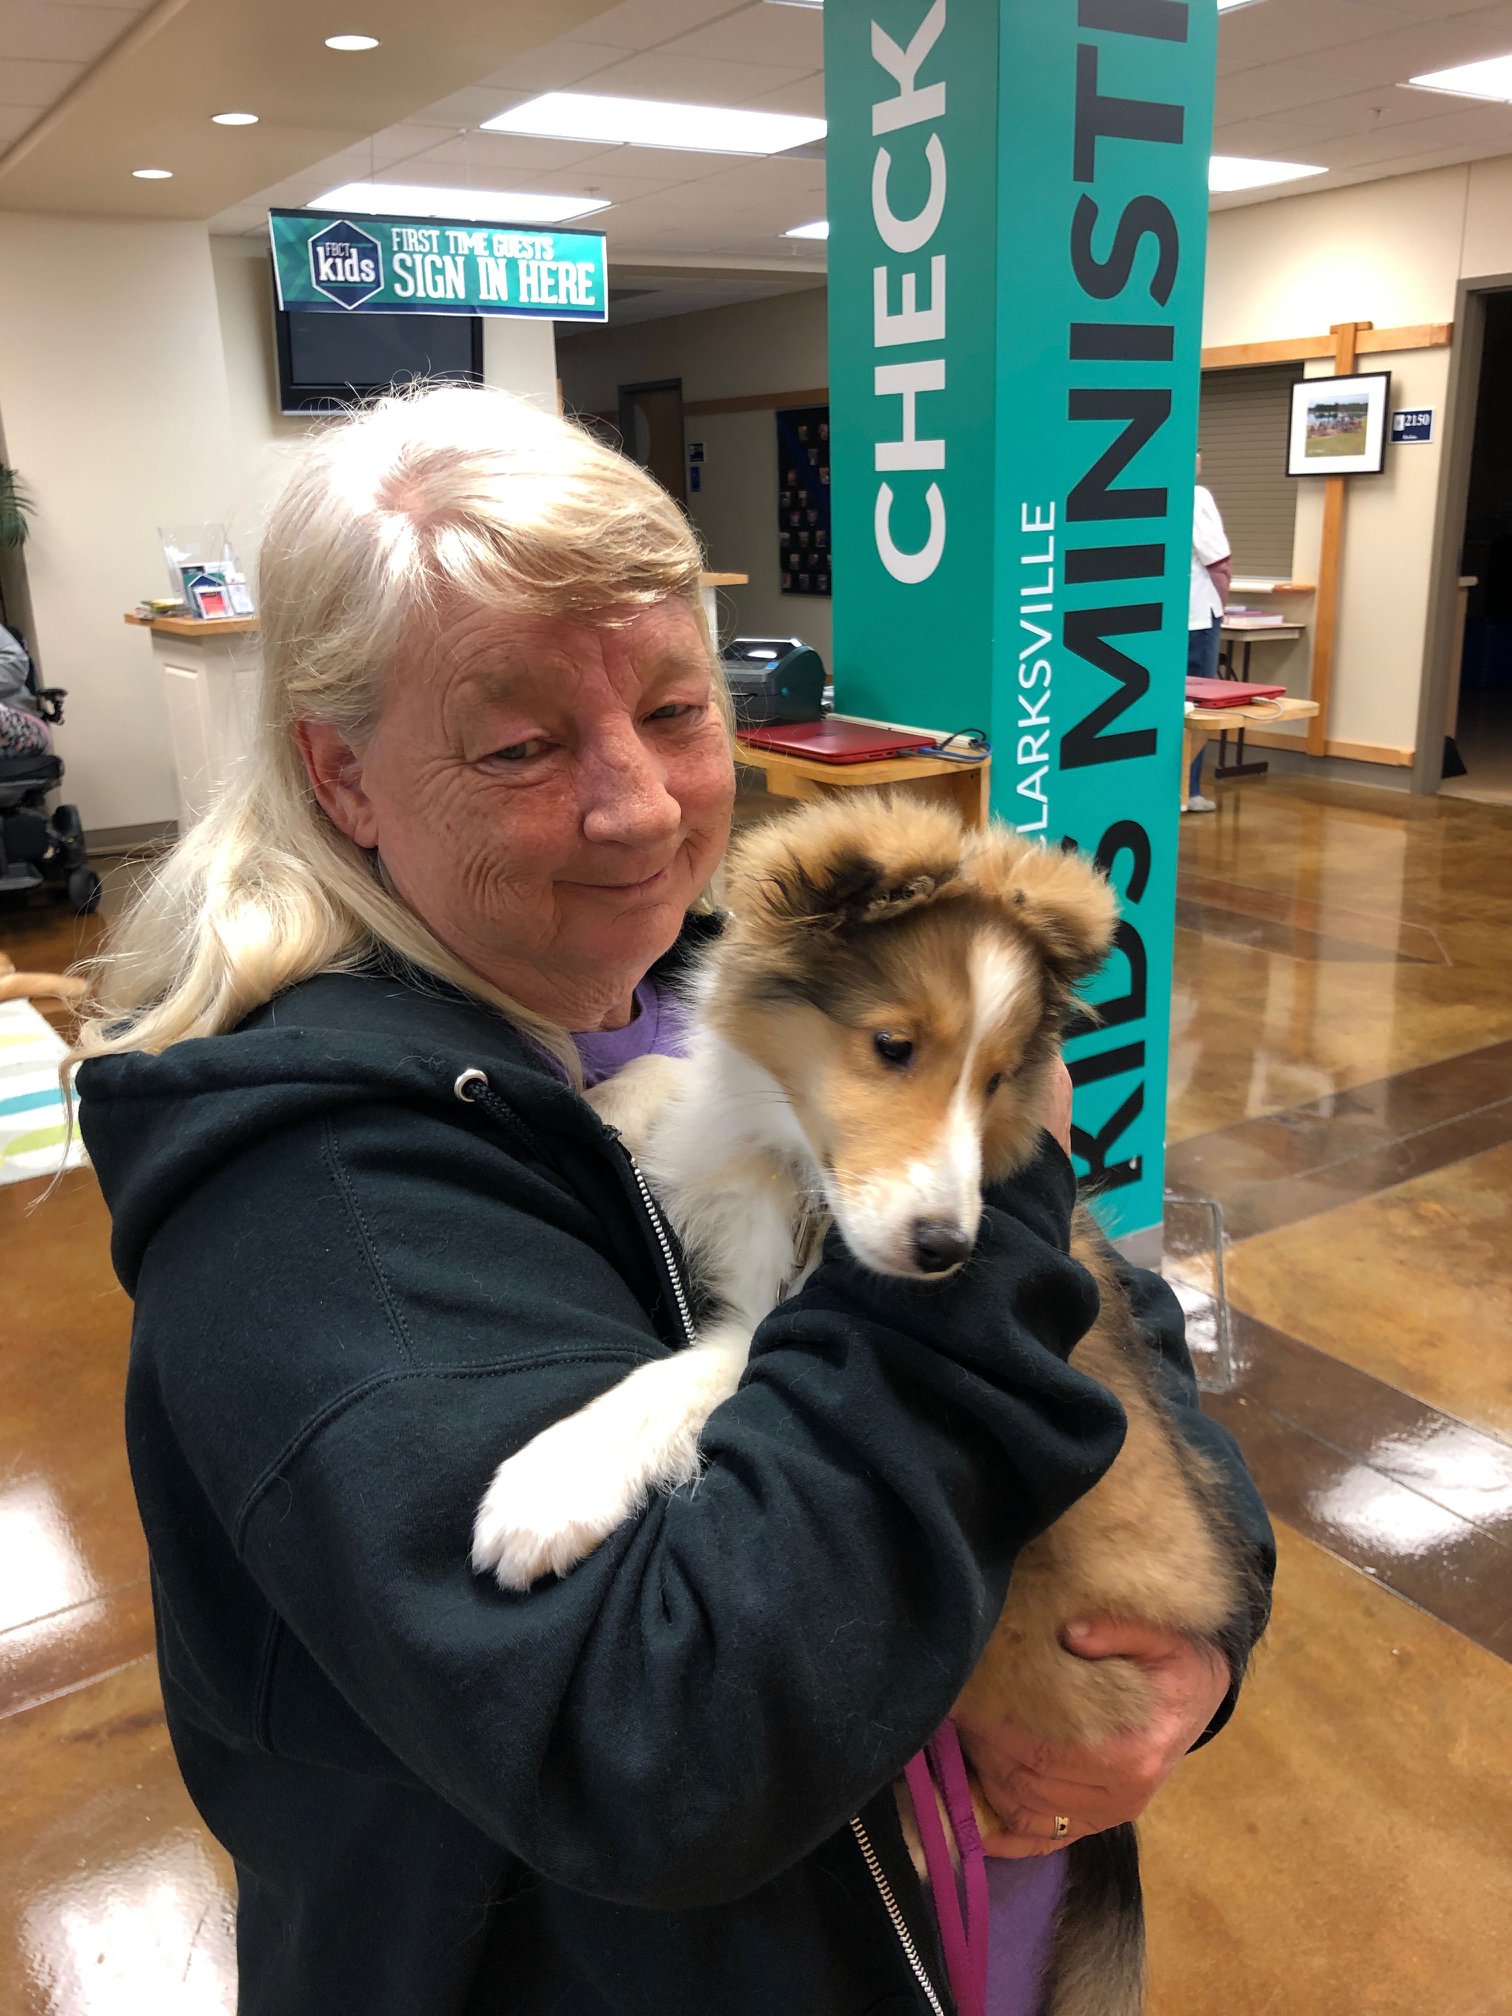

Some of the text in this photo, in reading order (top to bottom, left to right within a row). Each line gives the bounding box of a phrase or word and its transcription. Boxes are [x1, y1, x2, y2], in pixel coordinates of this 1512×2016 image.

[325, 242, 350, 256] FBCT
[391, 228, 555, 261] FIRST TIME GUESTS
[316, 246, 376, 283] kids
[392, 253, 596, 306] SIGN IN HERE
[870, 0, 947, 585] CHECK
[1404, 413, 1430, 427] 2150
[1014, 500, 1057, 853] LARKSVILLE
